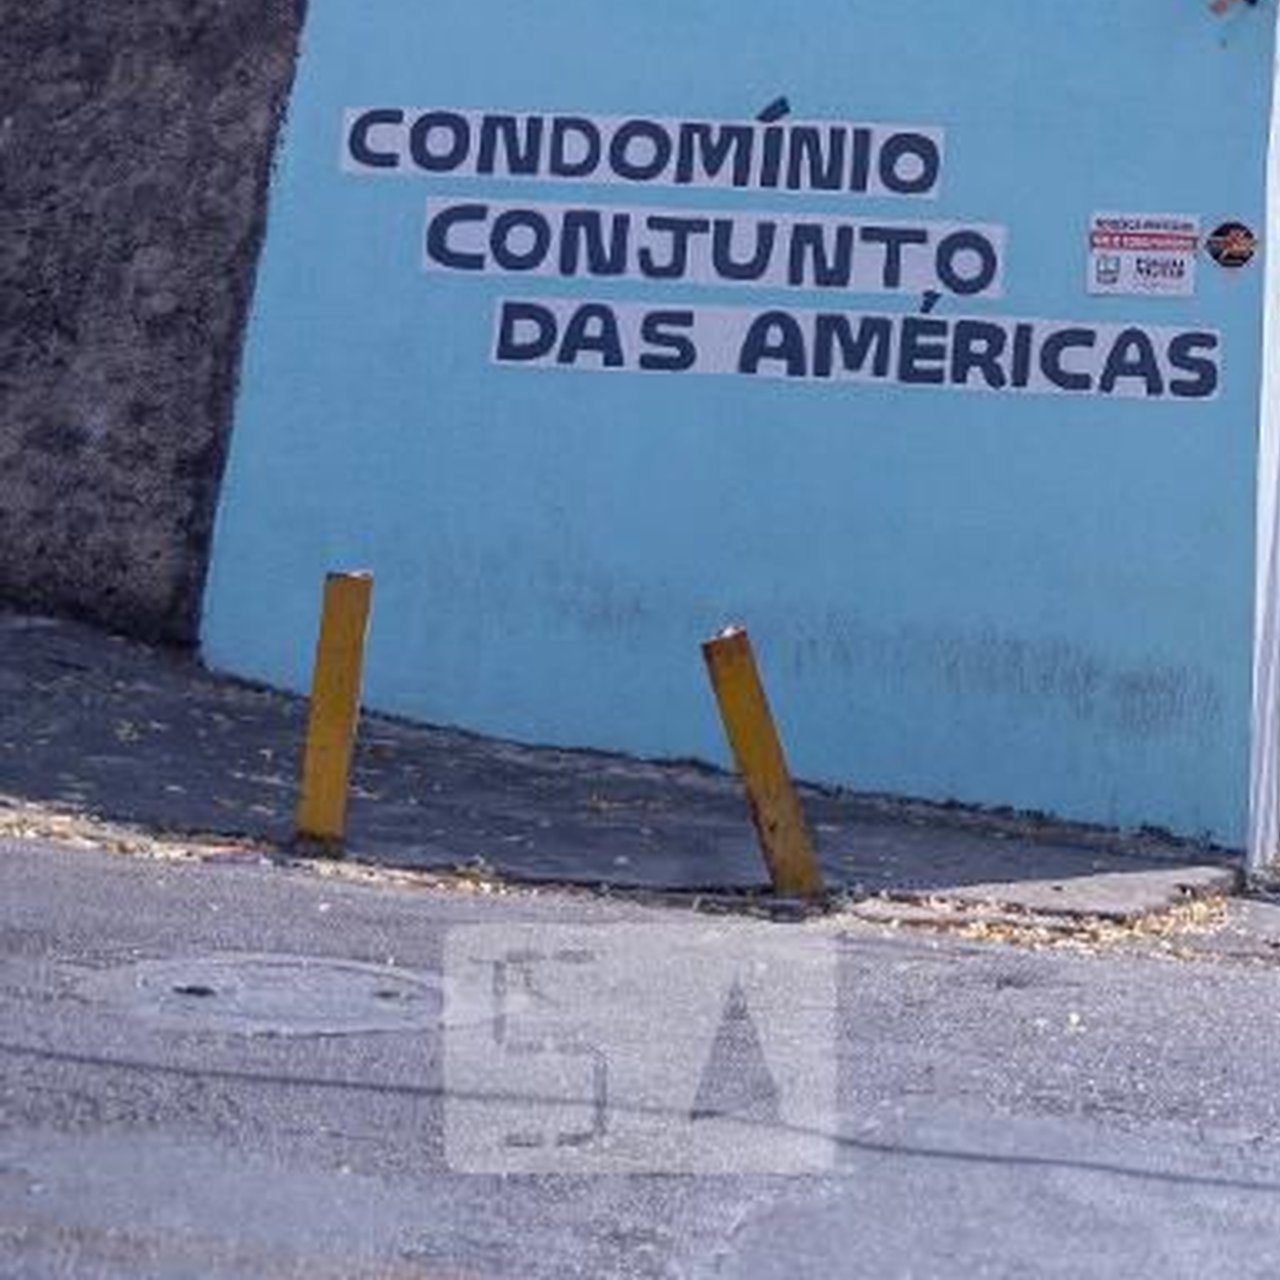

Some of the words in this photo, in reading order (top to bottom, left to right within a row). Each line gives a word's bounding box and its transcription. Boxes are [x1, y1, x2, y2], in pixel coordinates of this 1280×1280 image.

[348, 99, 940, 194] CONDOMÍNIO
[426, 204, 998, 295] CONJUNTO
[496, 301, 697, 371] DAS
[737, 290, 1219, 397] AMÉRICAS
